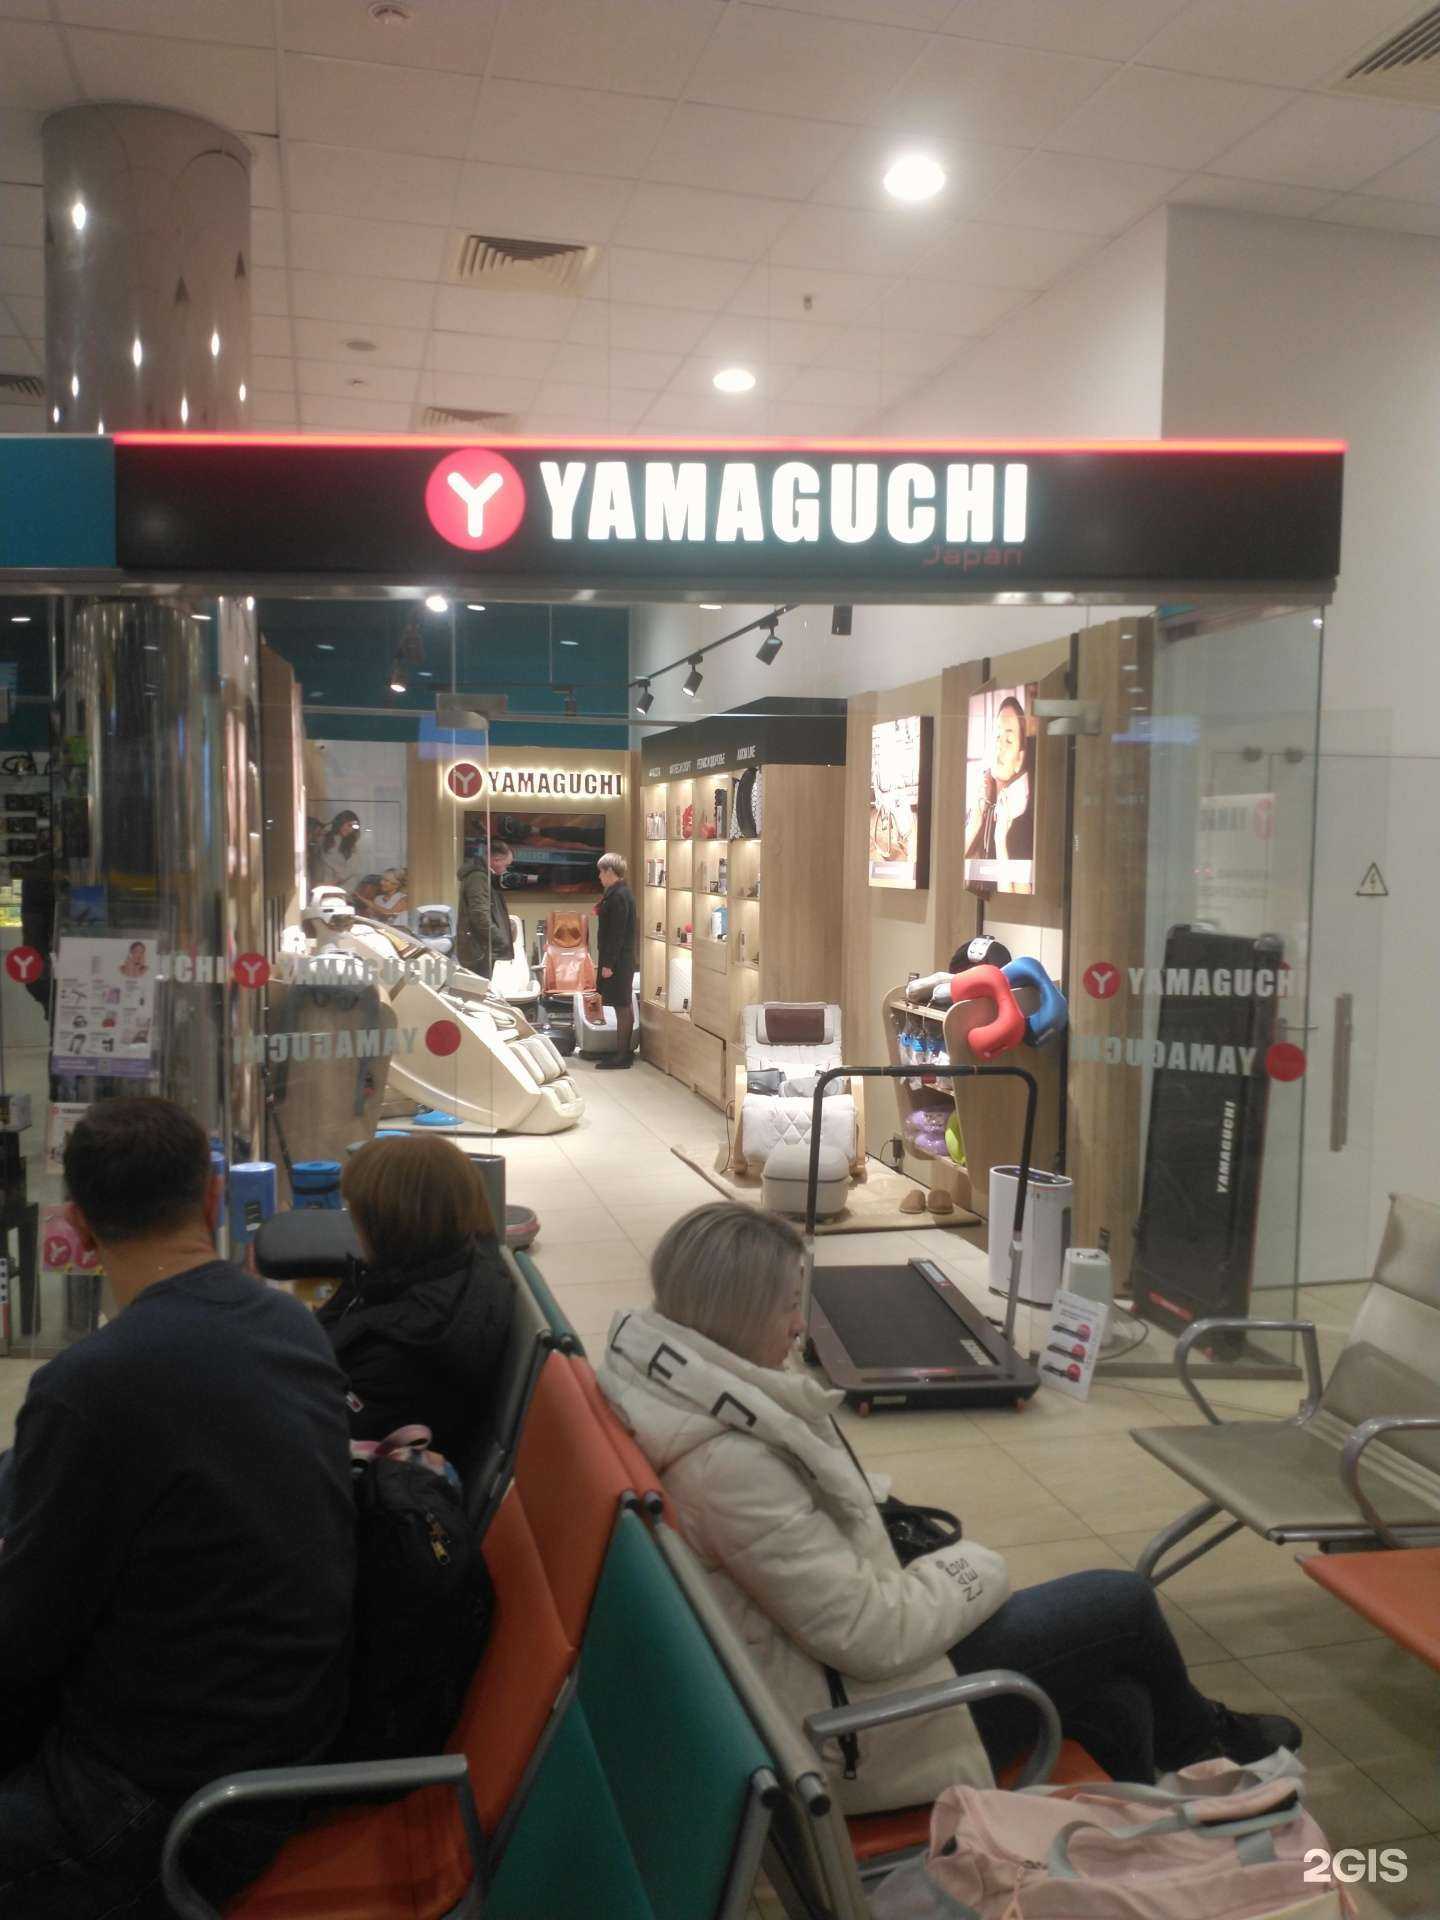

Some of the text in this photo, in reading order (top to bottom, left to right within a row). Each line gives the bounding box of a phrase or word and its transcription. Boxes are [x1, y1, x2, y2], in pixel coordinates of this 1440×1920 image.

[539, 461, 1029, 543] YAMAGUCHI
[922, 544, 1025, 573] Japan
[488, 771, 622, 796] YAMAGUCHI
[1216, 1100, 1236, 1193] YAMAGUCHI
